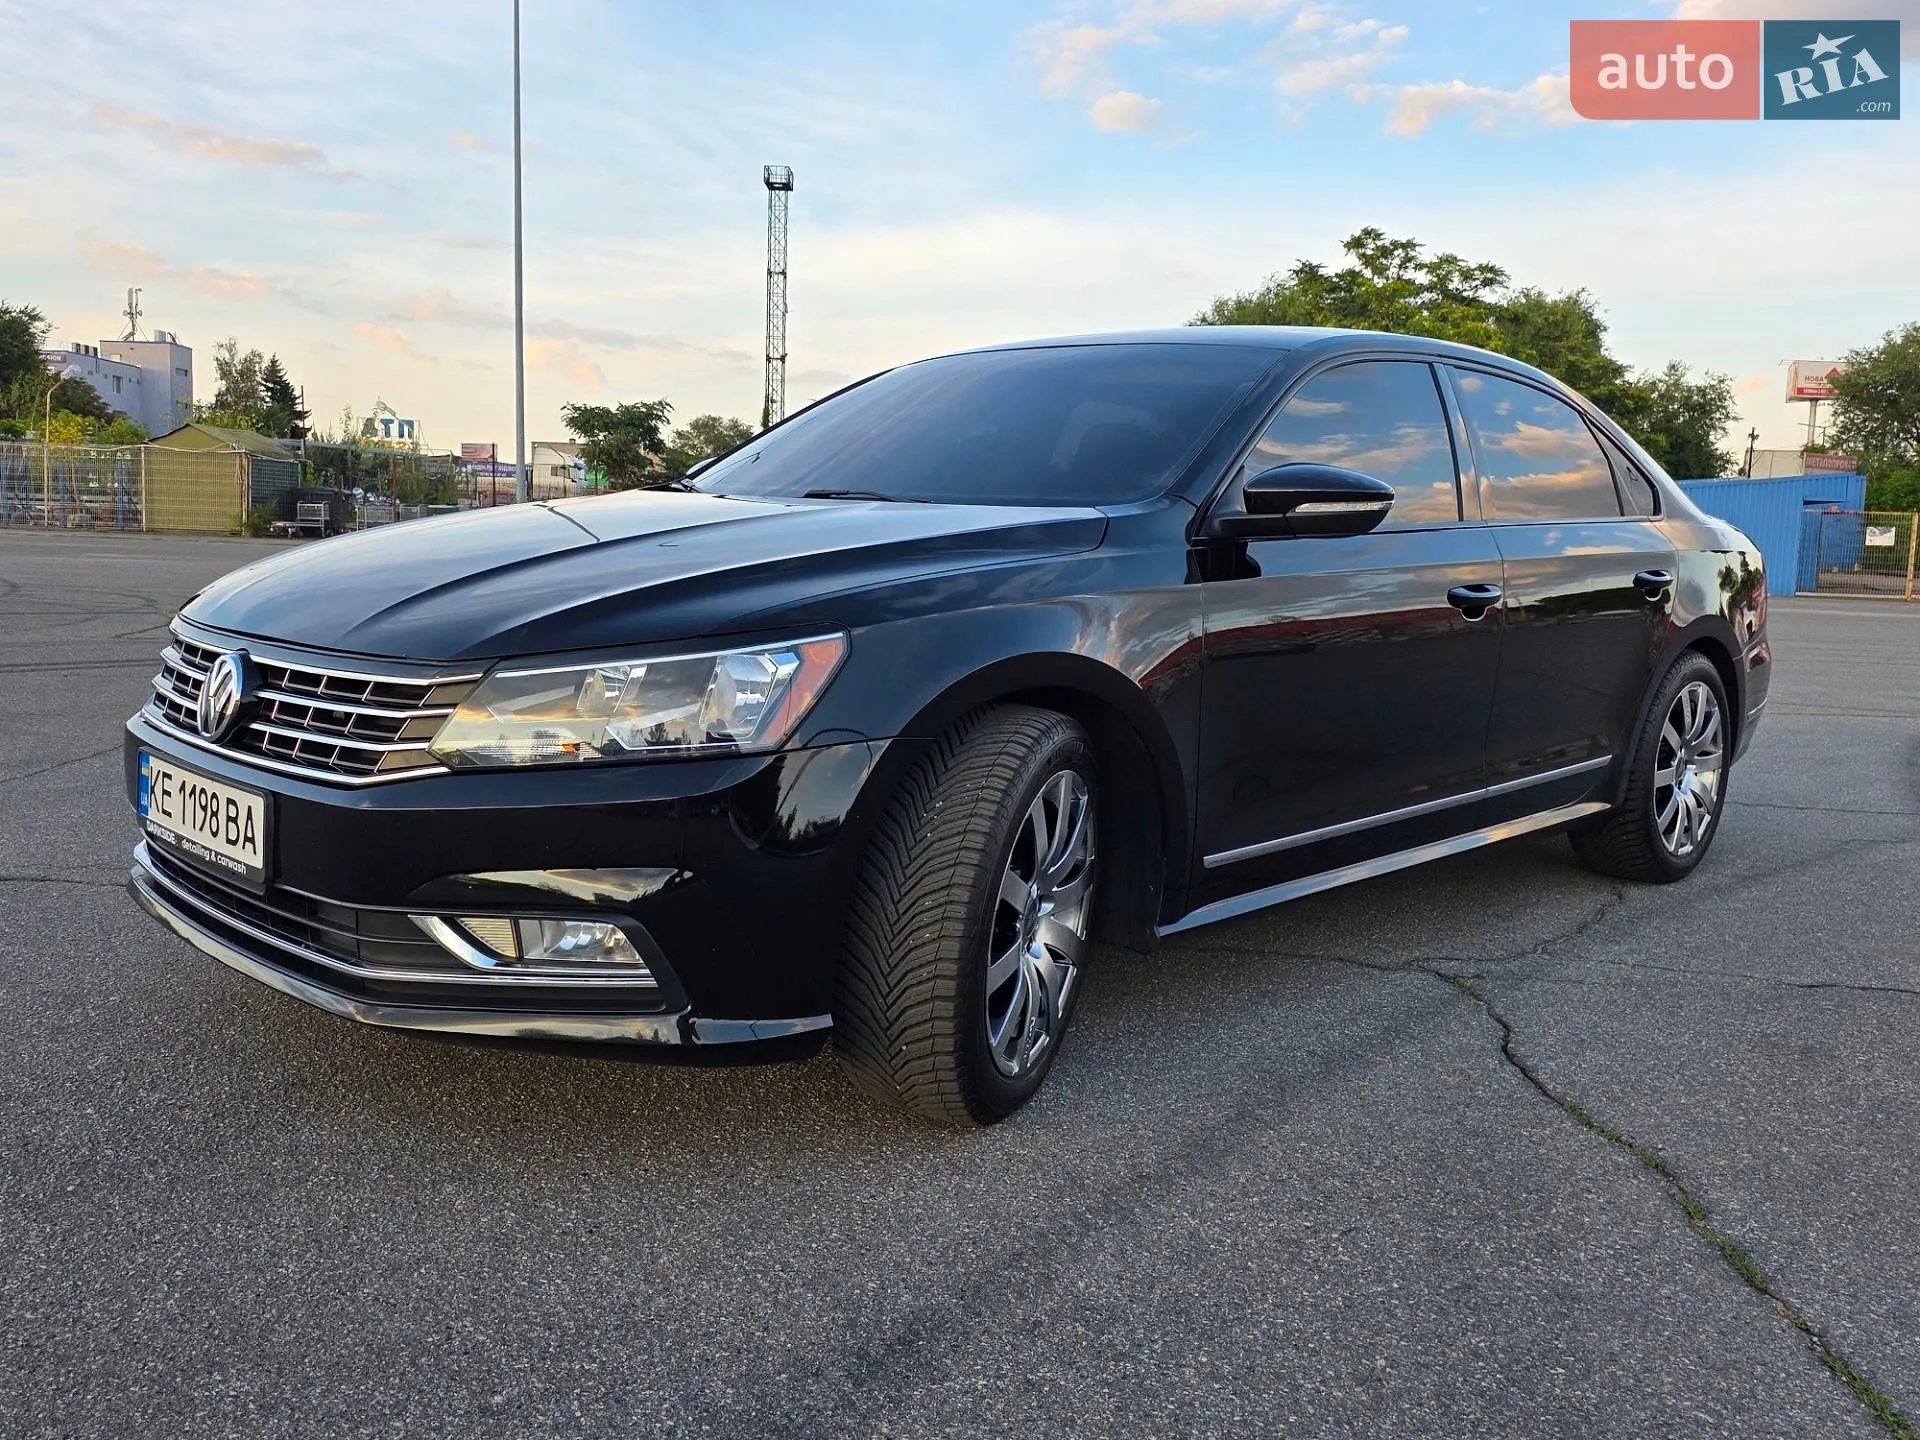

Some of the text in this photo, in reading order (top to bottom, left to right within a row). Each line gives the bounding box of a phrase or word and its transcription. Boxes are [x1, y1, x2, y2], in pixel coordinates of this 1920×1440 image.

[149, 766, 257, 855] KE 1198 BA
[181, 839, 210, 862] detailing
[210, 850, 217, 863] &
[217, 854, 247, 875] carwash
